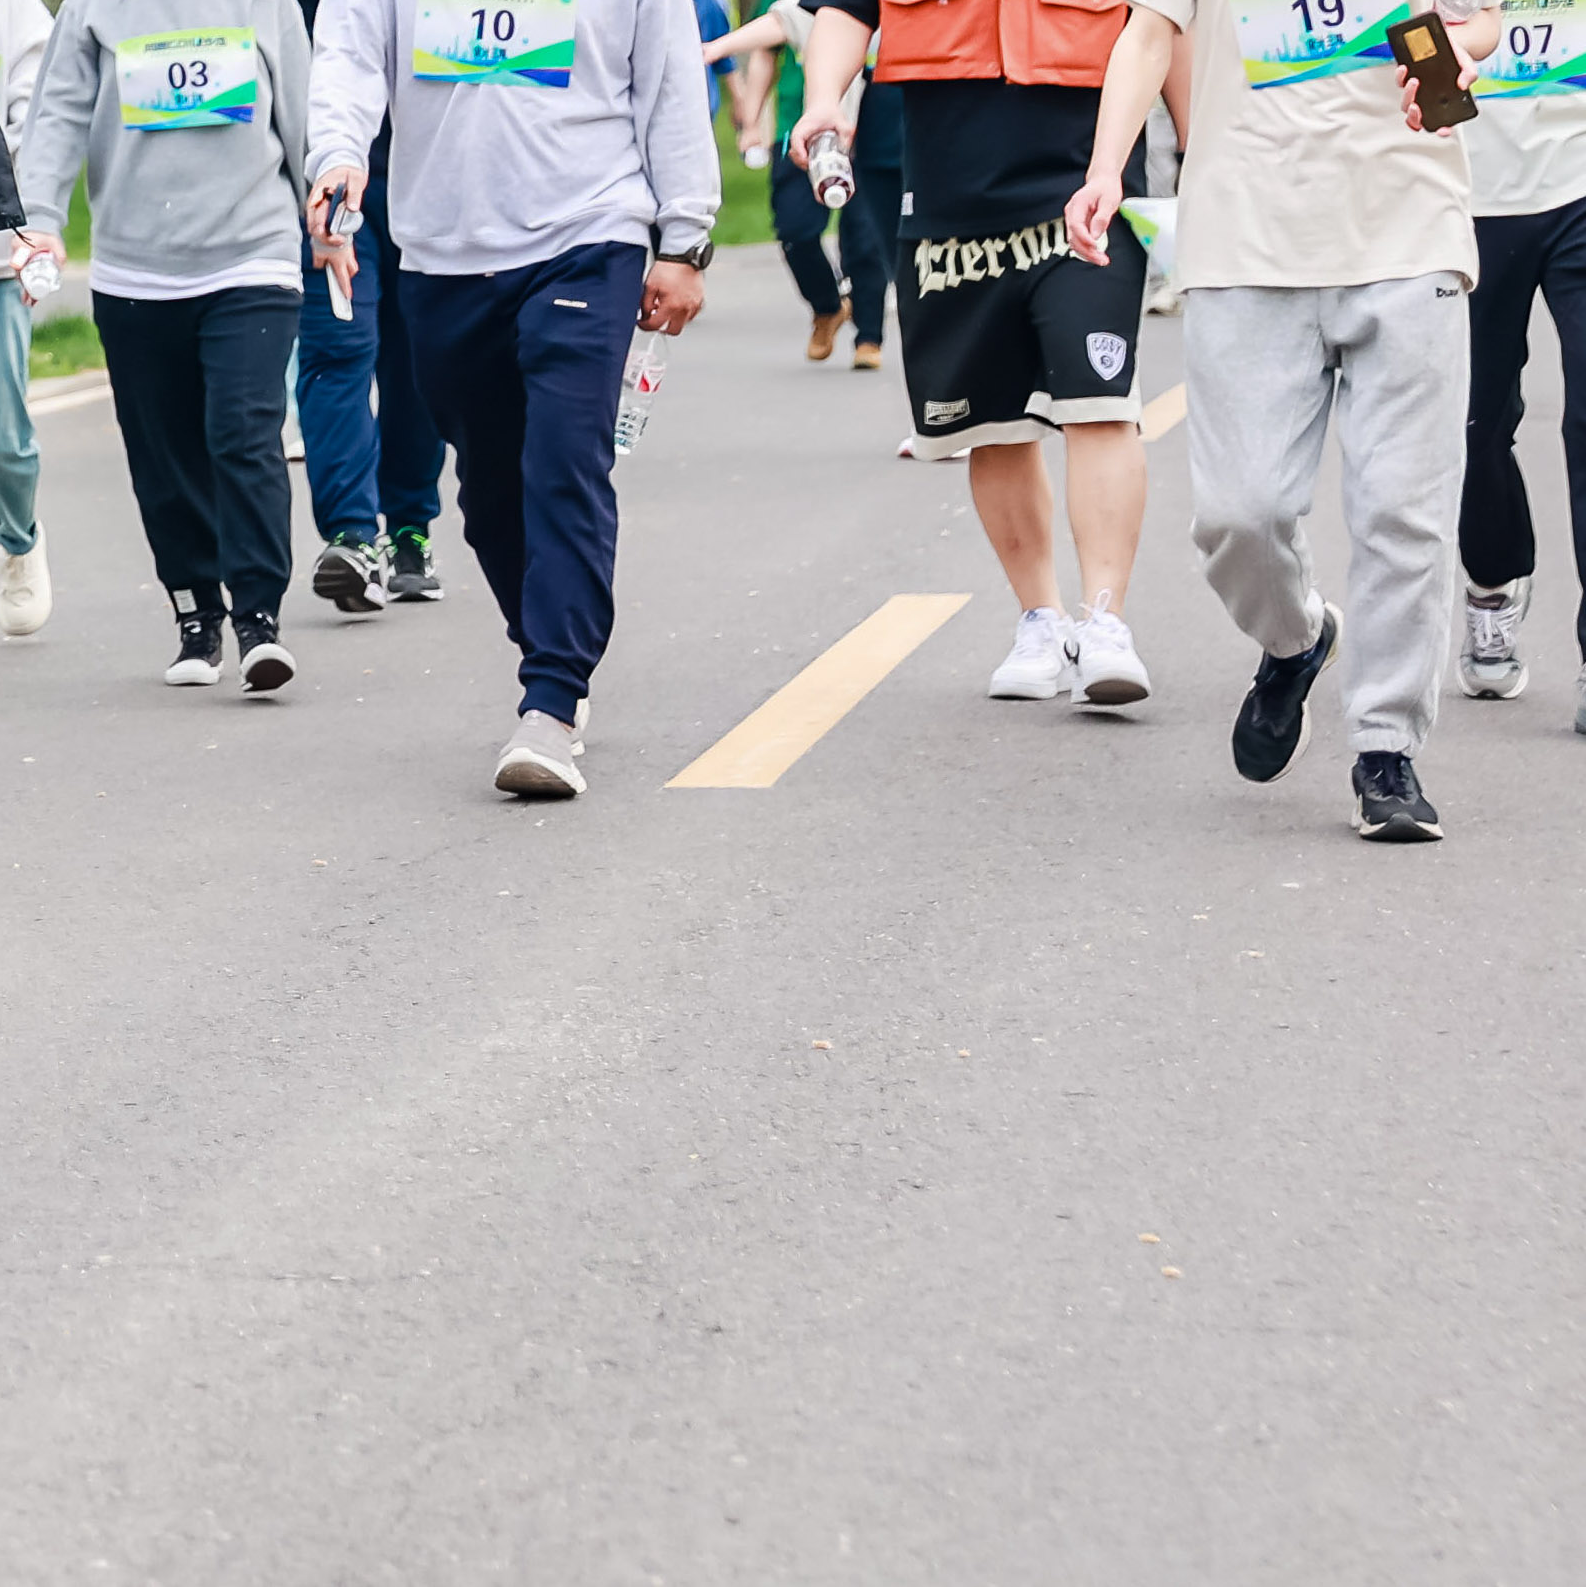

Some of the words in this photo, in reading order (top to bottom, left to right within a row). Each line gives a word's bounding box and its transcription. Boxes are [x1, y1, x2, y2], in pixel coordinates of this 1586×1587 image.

[472, 9, 515, 41] 10
[1509, 24, 1552, 55] 07
[168, 60, 208, 89] 03
